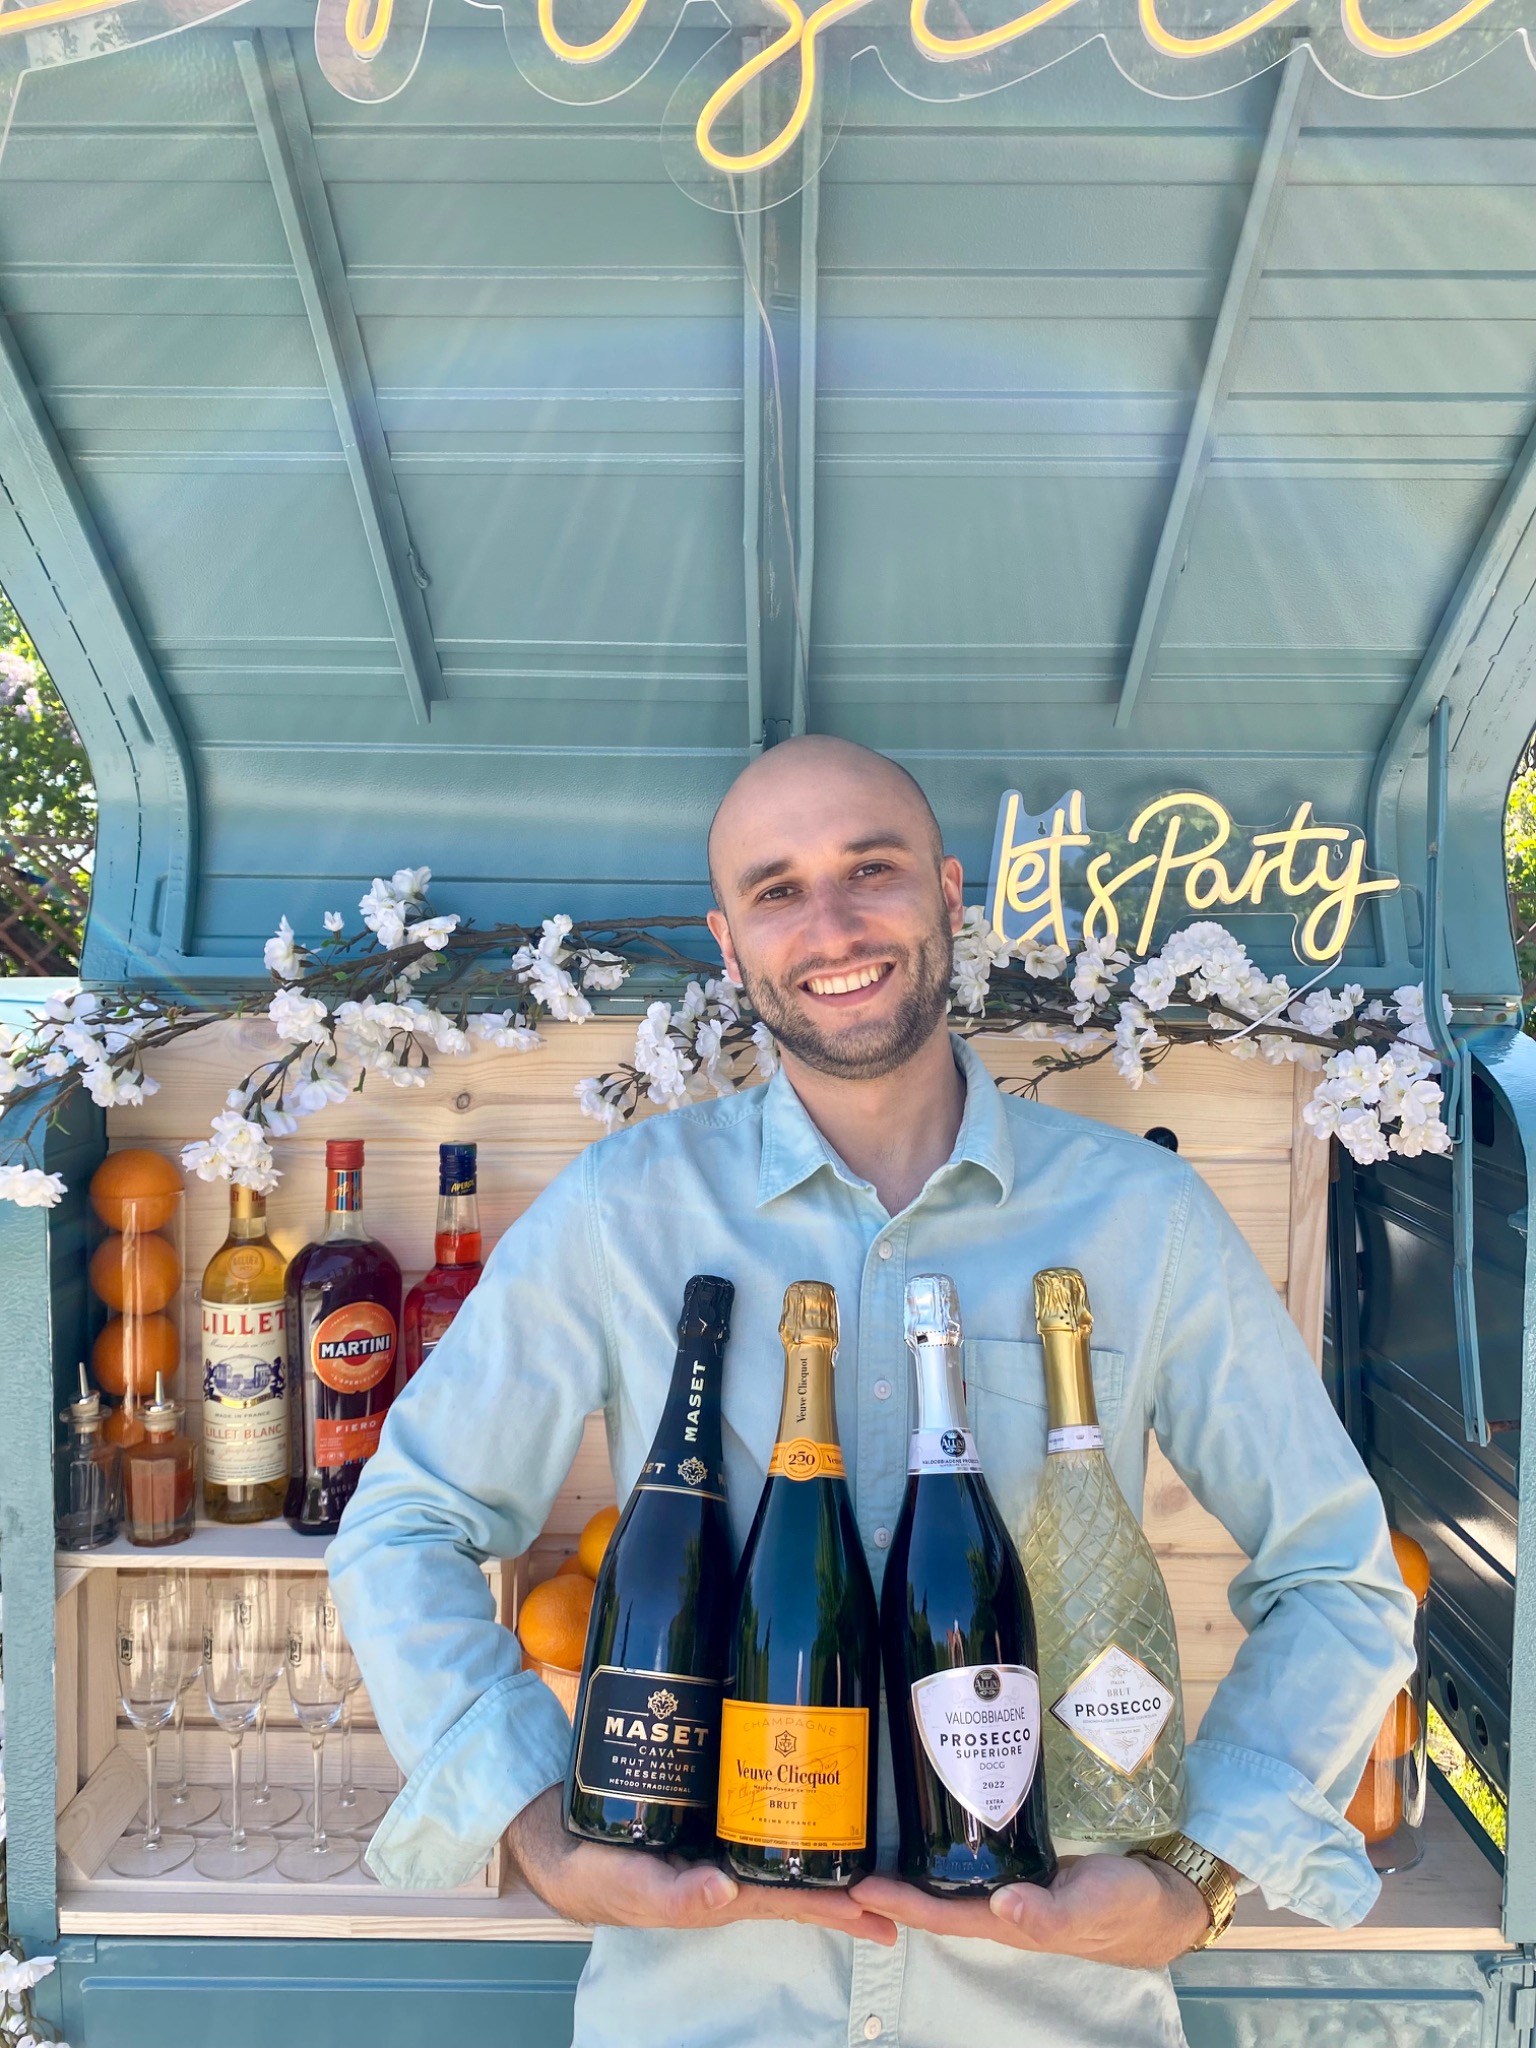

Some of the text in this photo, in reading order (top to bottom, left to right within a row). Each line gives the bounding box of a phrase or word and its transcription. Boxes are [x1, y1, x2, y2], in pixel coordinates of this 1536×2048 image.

[1128, 792, 1401, 961] Party
[203, 1309, 287, 1335] LILLET
[321, 1335, 391, 1358] MARTINI
[796, 1357, 809, 1424] Veuve Clicquot
[684, 1360, 706, 1442] MASET
[205, 1424, 282, 1440] LILLET BLANC
[335, 1420, 377, 1434] FIERO
[788, 1451, 816, 1466] 250
[1106, 1687, 1131, 1697] BRUT
[945, 1706, 1026, 1725] VALDOBBIADENE
[1075, 1697, 1161, 1717] PROSECCO
[604, 1716, 709, 1746] MASET
[743, 1717, 838, 1737] CHAMPAGNE
[940, 1728, 1031, 1746] PROSECCO
[639, 1745, 675, 1758] CAVA
[956, 1745, 1023, 1759] SUPERIORE
[612, 1755, 697, 1773] BRUT NATURE
[979, 1761, 1006, 1770] DOCG
[625, 1768, 682, 1783] RESERVA
[736, 1759, 841, 1788] Veuve Clicquot
[642, 1782, 692, 1793] TRADICIONAL
[982, 1781, 1005, 1790] 2022
[769, 1799, 798, 1810] BRUT
